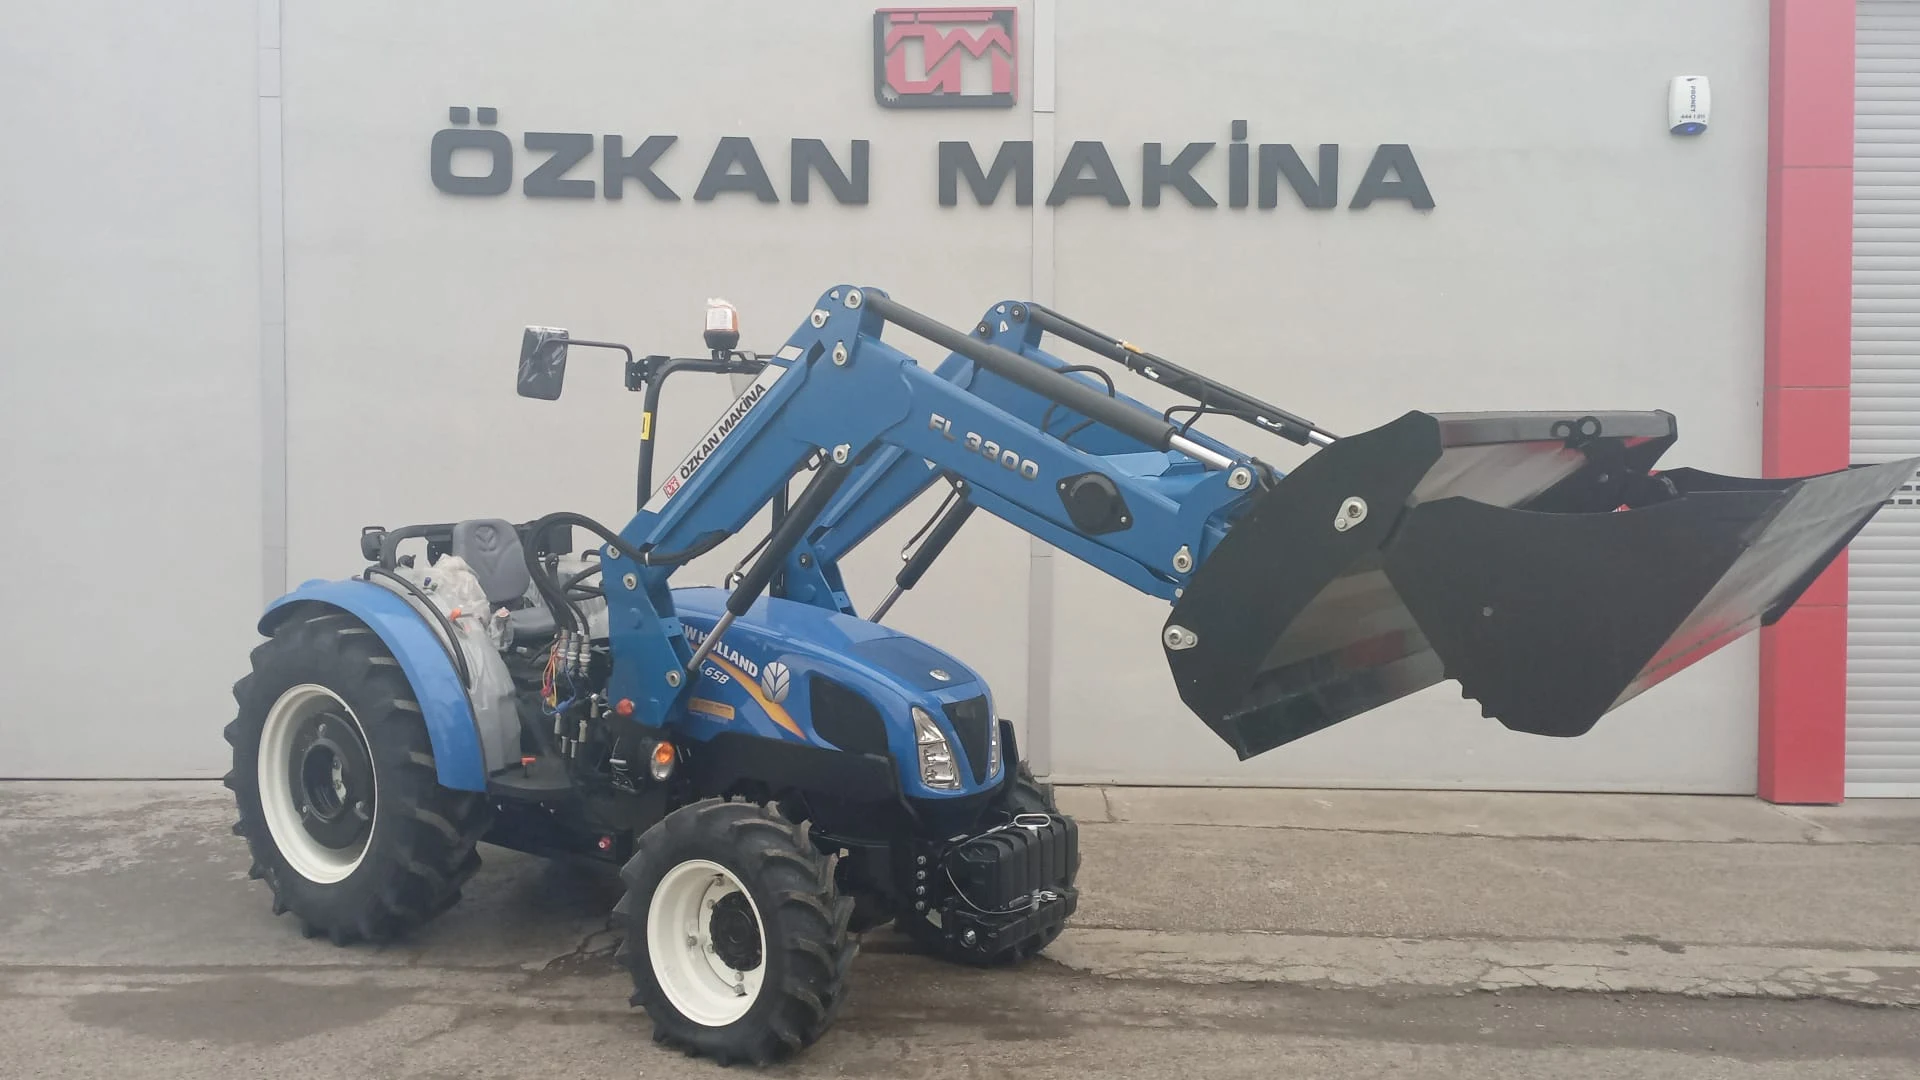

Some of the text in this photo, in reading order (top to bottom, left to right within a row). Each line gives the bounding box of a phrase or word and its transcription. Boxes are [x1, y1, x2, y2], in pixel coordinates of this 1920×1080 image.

[430, 106, 1436, 209] ÖZKAN MAKİNA
[680, 433, 720, 479] ÖZKAN
[718, 384, 767, 437] MAKİNA
[929, 412, 1039, 480] FL 3300
[697, 631, 759, 678] HLLAND
